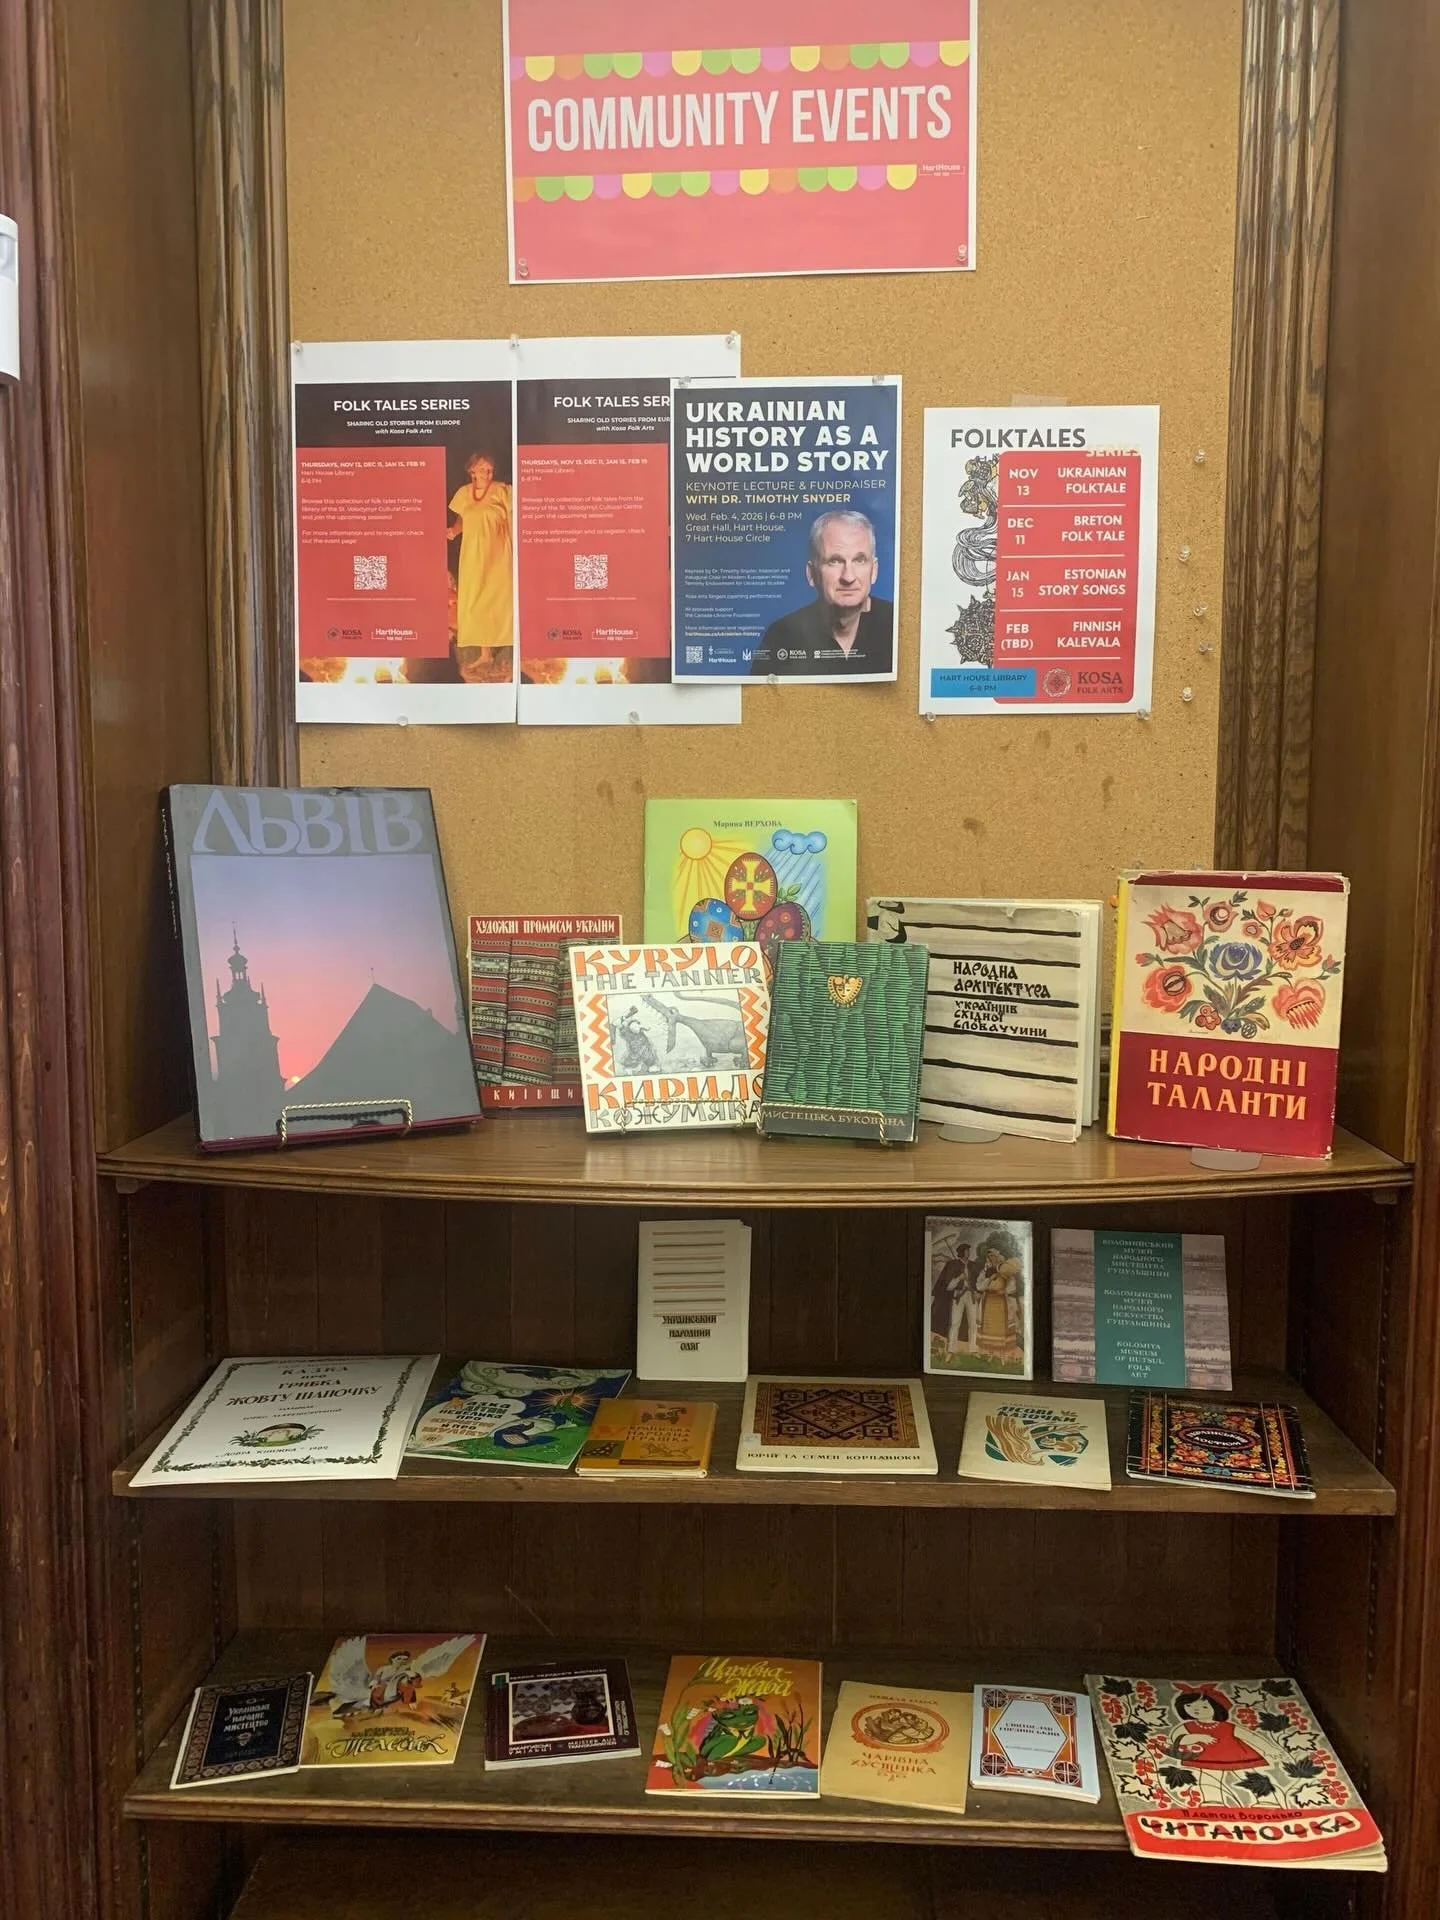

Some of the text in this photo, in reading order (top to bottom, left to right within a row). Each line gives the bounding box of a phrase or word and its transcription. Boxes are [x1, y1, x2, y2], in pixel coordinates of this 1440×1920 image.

[527, 84, 952, 153] COMMUNITY EVENTS
[333, 398, 471, 412] FOLK TALES SERIES
[553, 396, 671, 408] FOLK TALES SER
[686, 400, 846, 422] UKRAINIAN
[685, 425, 880, 448] HISTORY AS A
[951, 428, 1086, 449] FOLKTALES
[685, 450, 889, 473] WORLD STORY
[1009, 468, 1039, 480] NOV
[1057, 467, 1127, 478] UKRAINIAN
[686, 480, 886, 492] KEYNOTE LECTURE & FUNDRAISER
[1016, 485, 1030, 496] 13
[1065, 483, 1126, 494] FOLKTALE
[685, 493, 851, 505] WITH DR. TIMOTHY SNYDER
[731, 512, 740, 522] 4,
[741, 512, 764, 521] 2026
[769, 512, 786, 521] 6-8
[788, 511, 803, 521] PM
[1007, 517, 1034, 528] DEC
[1073, 515, 1122, 526] BRETON
[685, 523, 710, 532] Great
[712, 523, 732, 533] Hall,
[733, 523, 753, 532] Hart
[685, 533, 771, 542] 7 Hart House Circle
[1014, 534, 1025, 545] 11
[1061, 531, 1125, 542] FOLK TALE
[1006, 570, 1030, 581] JAN
[1063, 569, 1127, 580] ESTONIAN
[1011, 588, 1024, 598] 15
[1039, 584, 1126, 596] STORY SONGS
[375, 628, 413, 636] HartHouse
[596, 628, 634, 636] HartHouse
[1006, 623, 1029, 634] FEB
[1072, 621, 1121, 632] FINNISH
[1001, 638, 1033, 650] (TBD)
[1057, 637, 1121, 648] KALEVALA
[1077, 670, 1123, 686] KOSA
[1077, 686, 1124, 695] FOLK ARTS
[191, 789, 422, 856] ЛЬВІВ
[712, 819, 782, 829] Марина ВЕРХОВА
[475, 918, 615, 935] ХУДОЖНІ ПРОМИСЛИ УКРАЇНИ
[573, 945, 758, 977] KYRYLO
[953, 961, 1018, 981] НАРОДНА
[575, 967, 763, 992] THE TANNER
[953, 979, 1051, 999] АРХІТЕКТУРА
[955, 1000, 1018, 1016] УКРАЇНЦІВ
[953, 1008, 1004, 1024] СХІДНОЇ
[953, 1020, 1048, 1038] СЛОВАЧЧИНИ
[1148, 1048, 1307, 1087] НАРОДНІ
[1146, 1081, 1307, 1121] ТАЛАНТИ
[761, 1110, 906, 1128] МИСТЕЦЬКА БУКОВИНА
[680, 1342, 700, 1352] ОДЯГ
[1120, 1348, 1158, 1358] MUSEUM
[281, 1366, 348, 1376] КАЗКА
[1127, 1363, 1152, 1373] FOLK
[1130, 1371, 1148, 1379] ART
[226, 1385, 383, 1406] ЖОВТУ ШАПОЧКУ
[1140, 1811, 1356, 1842] ЧИТАНОЧКА
